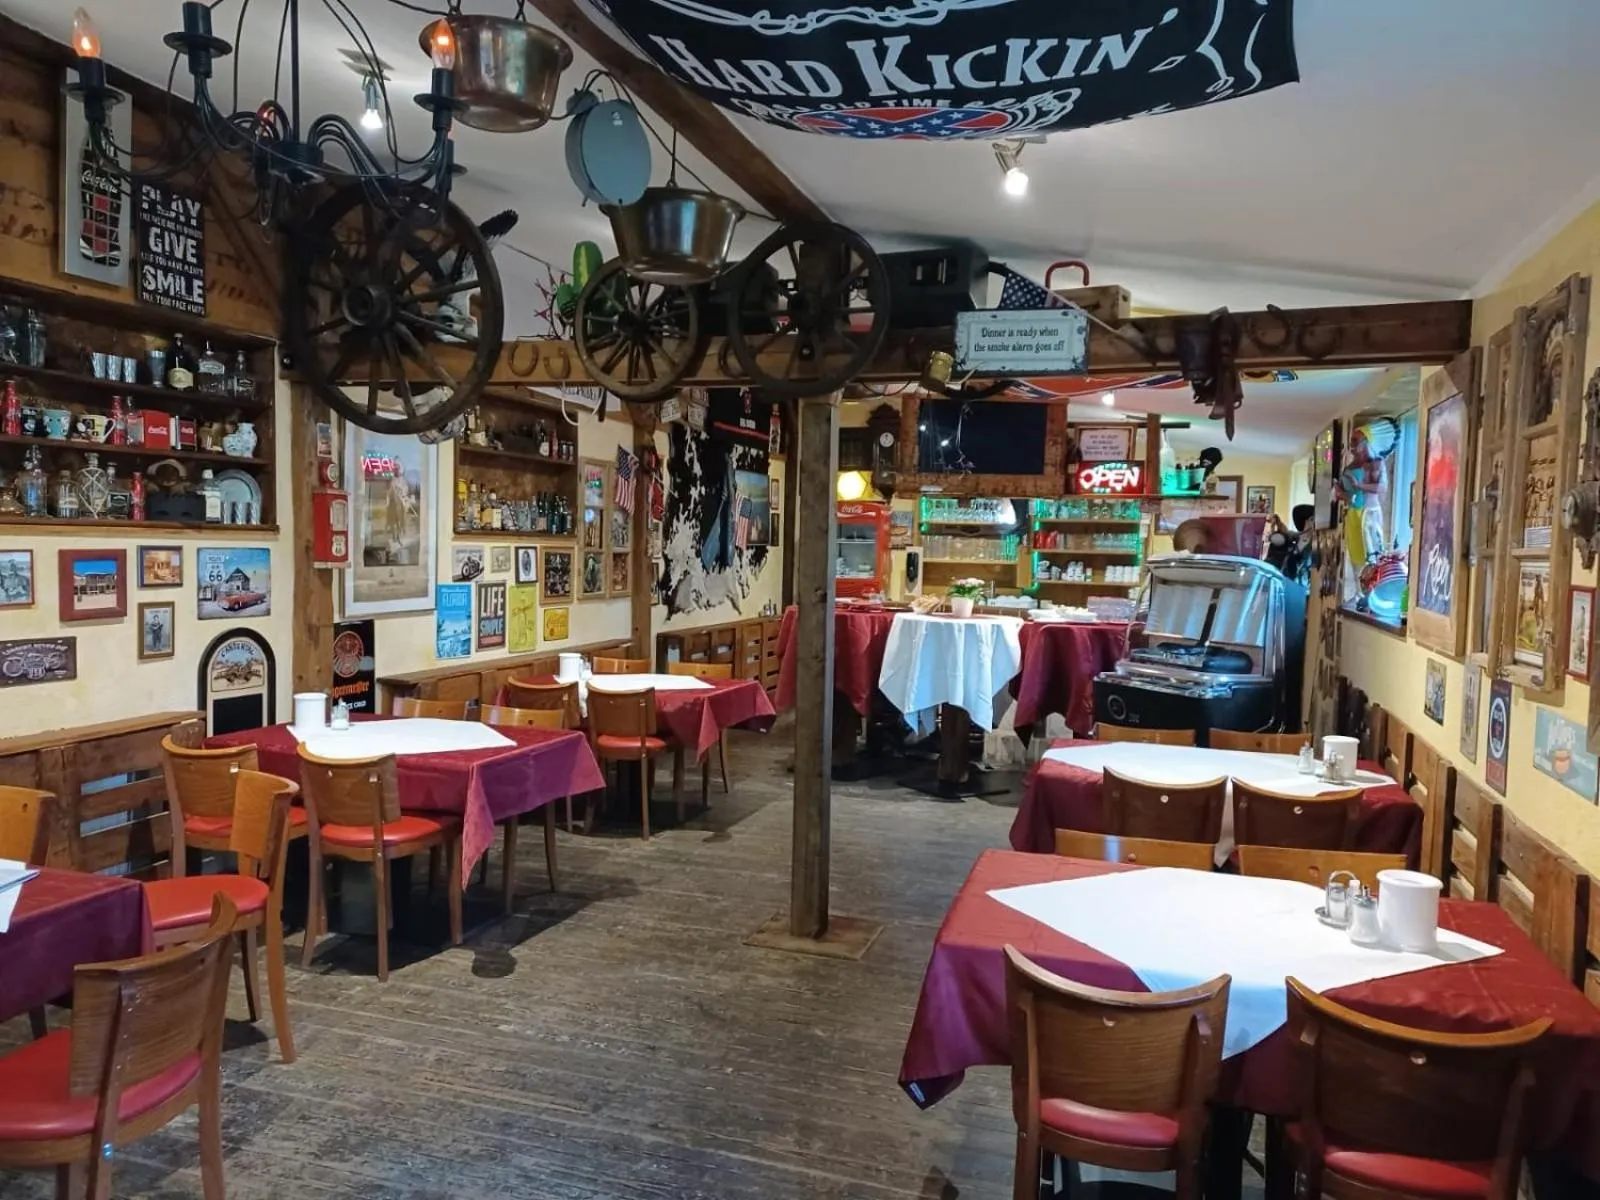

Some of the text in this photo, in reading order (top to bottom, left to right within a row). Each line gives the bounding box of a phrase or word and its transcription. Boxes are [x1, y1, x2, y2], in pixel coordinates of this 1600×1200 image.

[648, 33, 843, 97] HARD
[819, 101, 872, 111] OLD
[881, 98, 952, 108] TIME
[142, 185, 200, 226] PLAY
[149, 227, 197, 263] GIVE
[143, 265, 204, 304] SMILE
[981, 325, 1059, 340] Dinner is ready when
[974, 340, 1065, 354] the smoke alarm goes off
[1079, 466, 1140, 490] OPEN
[208, 570, 223, 582] 66
[480, 586, 504, 618] LIFE
[333, 681, 369, 698] germeister
